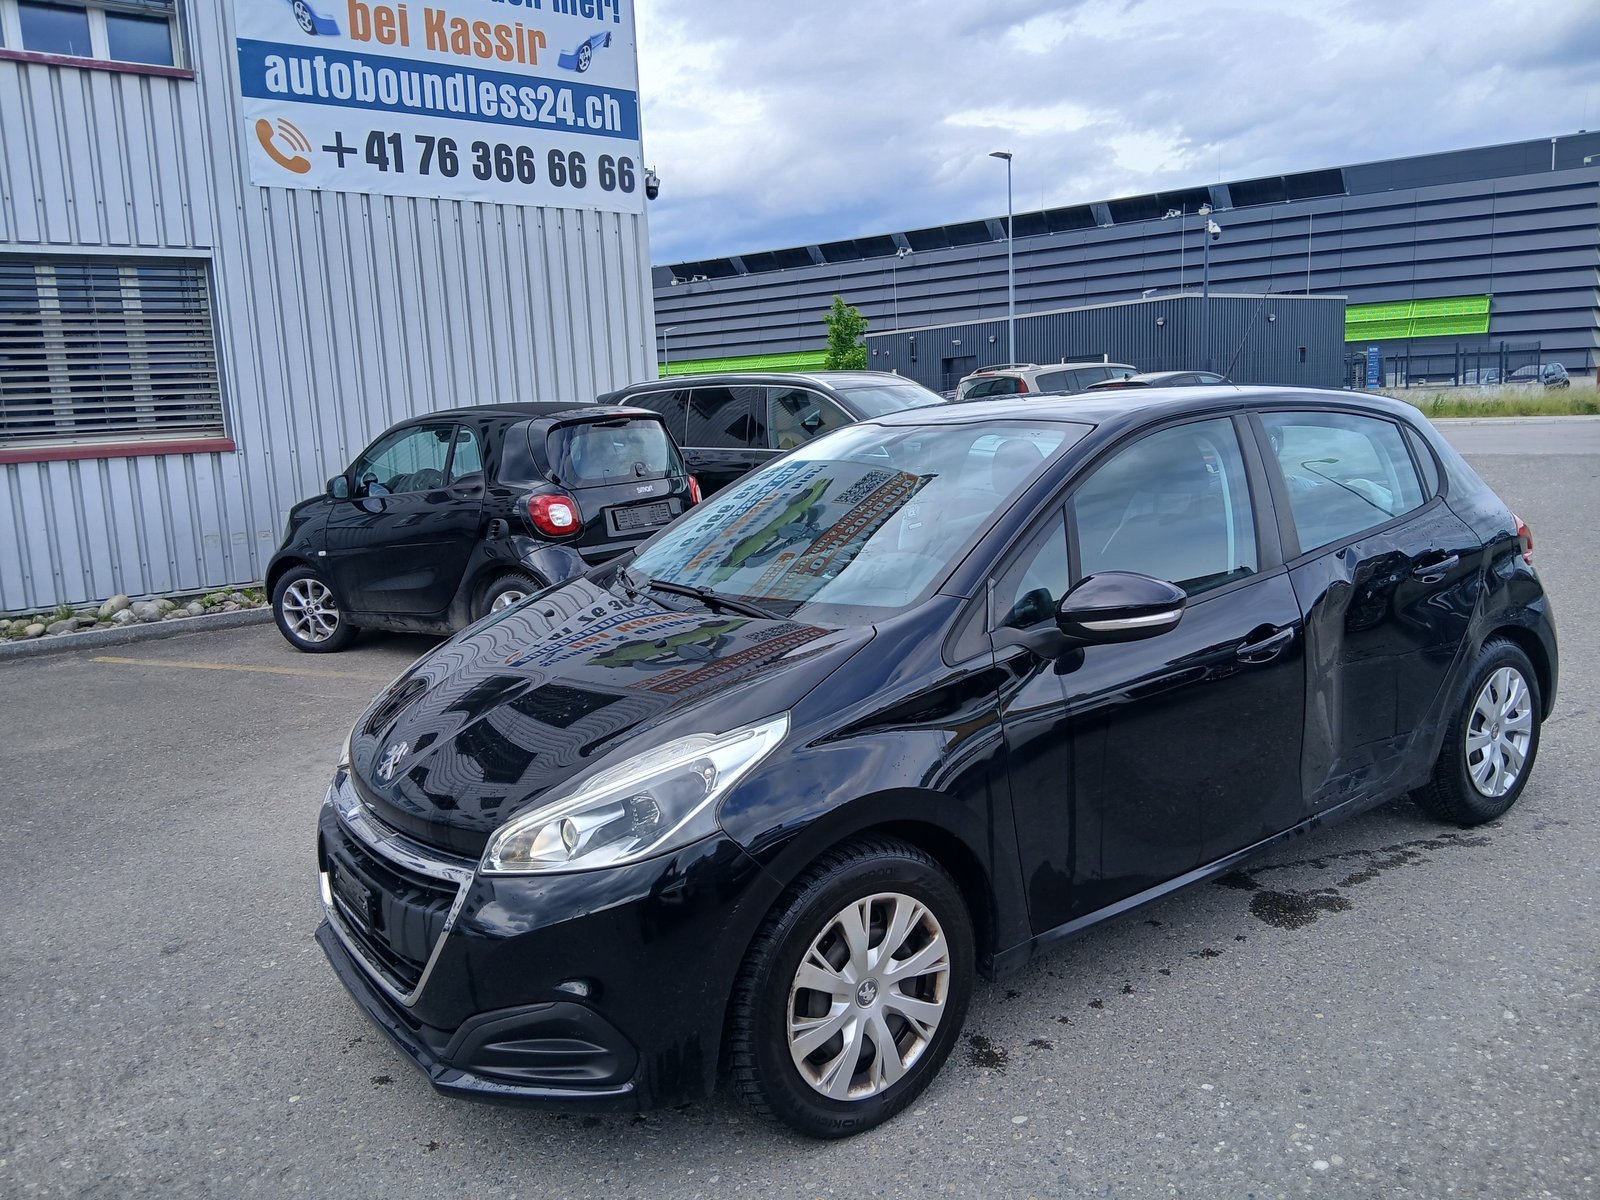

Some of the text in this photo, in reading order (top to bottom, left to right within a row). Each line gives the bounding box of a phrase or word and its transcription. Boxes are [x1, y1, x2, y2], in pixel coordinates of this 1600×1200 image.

[347, 0, 547, 66] bei Kassir
[264, 54, 621, 132] autoboundless24.ch
[322, 131, 635, 193] + 41 76 366 66 66
